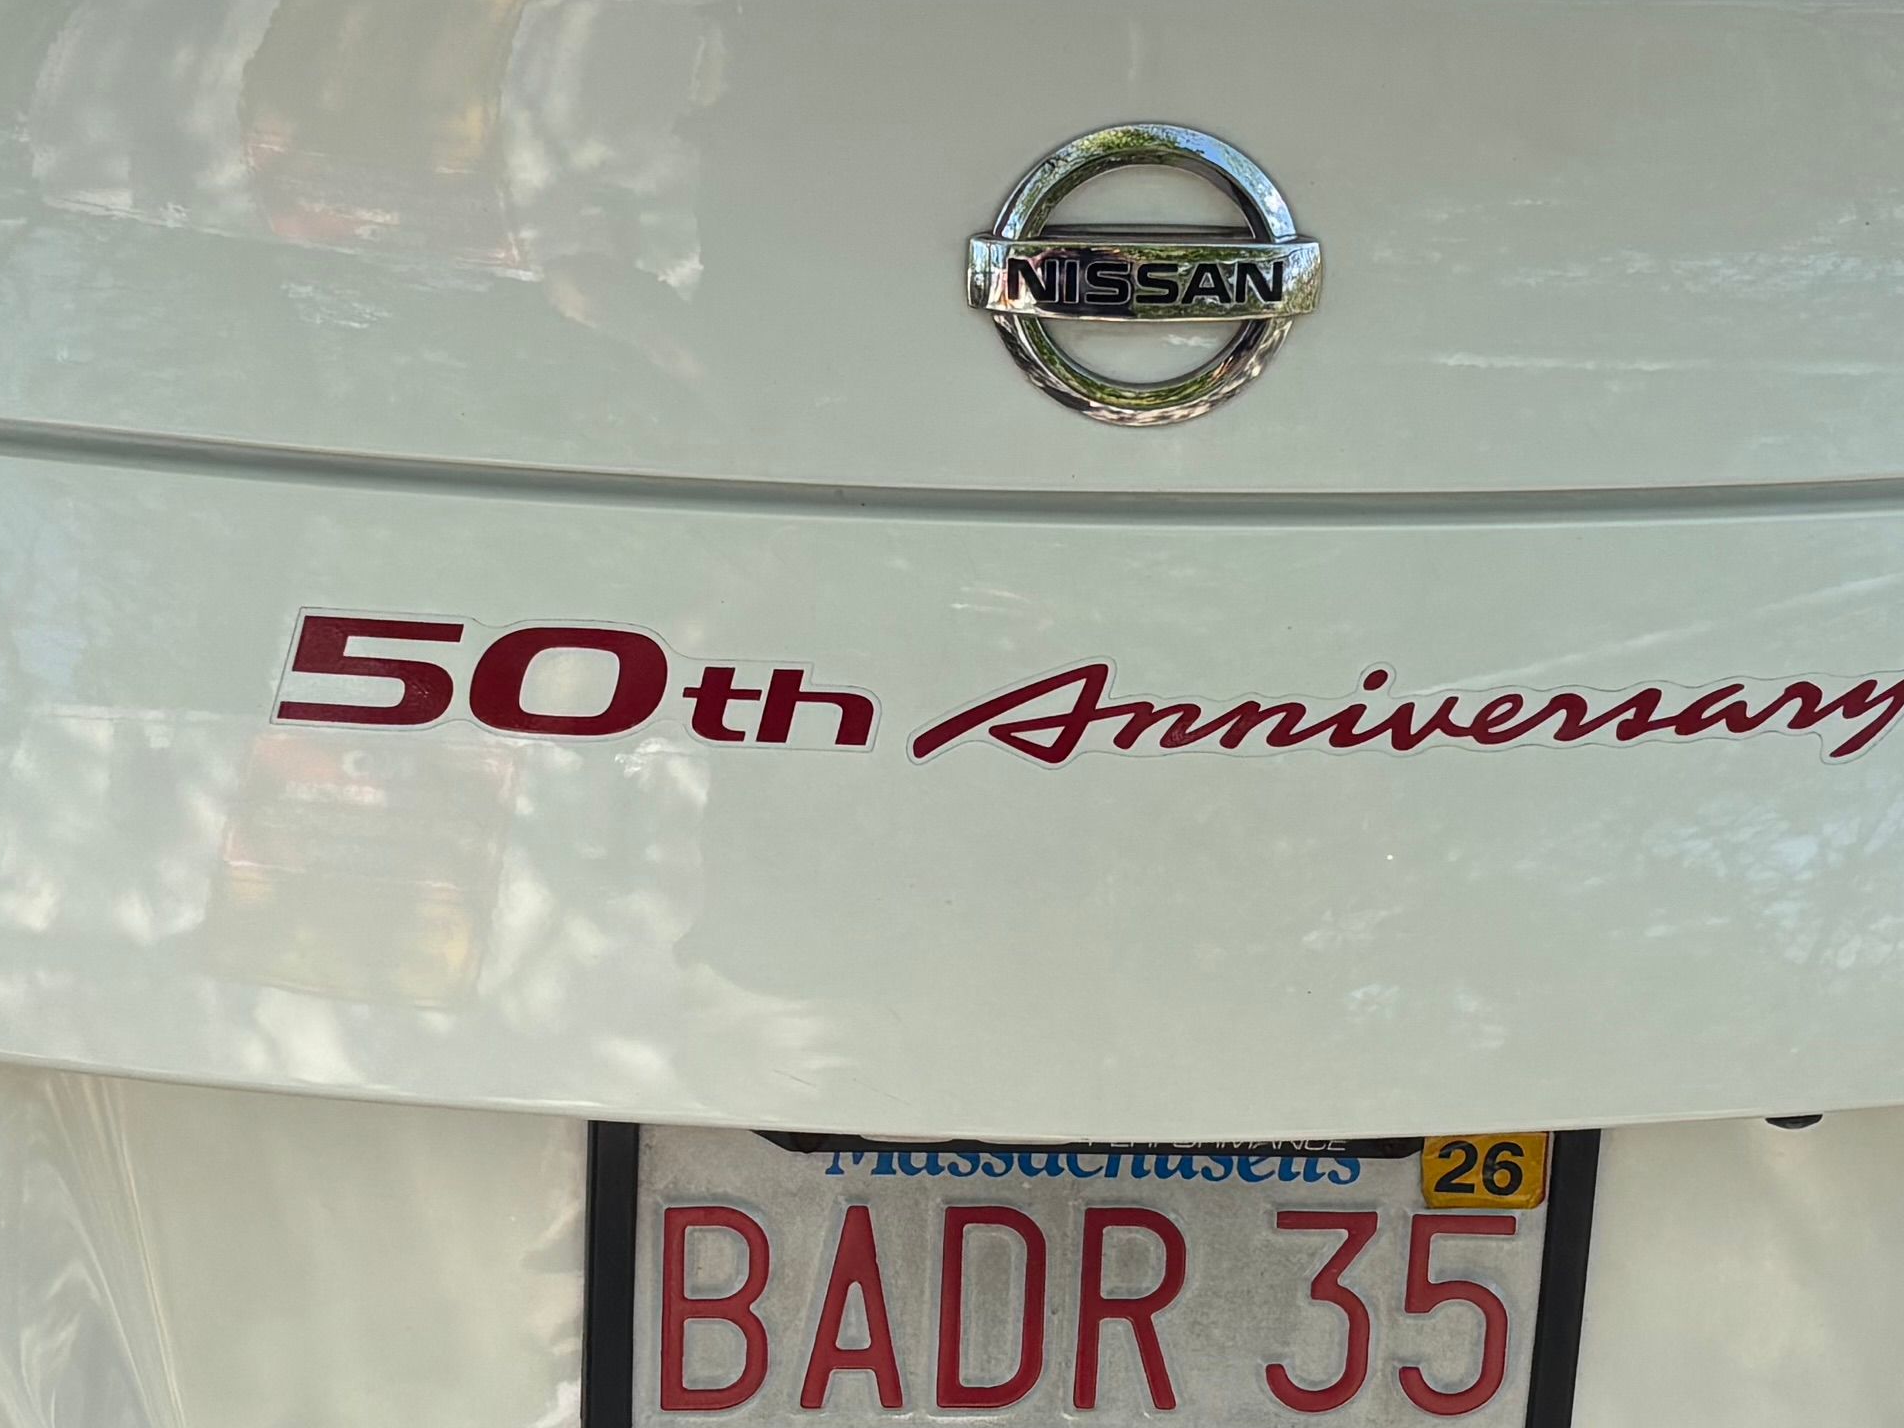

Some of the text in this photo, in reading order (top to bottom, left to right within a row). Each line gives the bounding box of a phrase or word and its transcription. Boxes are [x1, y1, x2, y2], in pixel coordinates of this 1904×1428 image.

[1006, 257, 1284, 305] NISSAN
[277, 615, 875, 746] 50th
[1434, 1140, 1525, 1196] 26
[659, 1204, 1518, 1417] BADR 35
